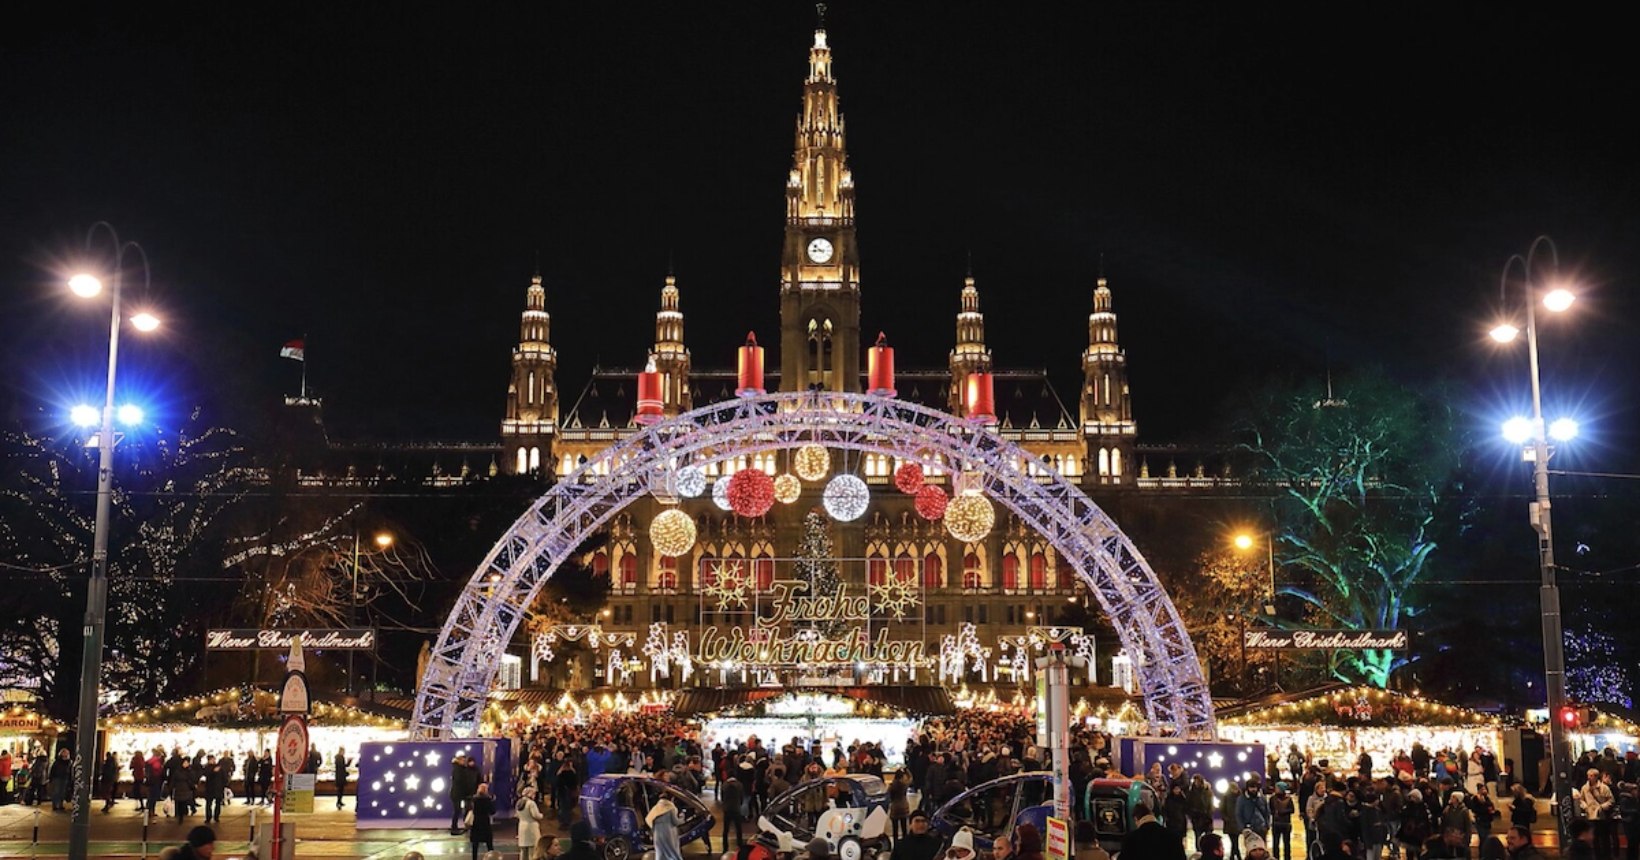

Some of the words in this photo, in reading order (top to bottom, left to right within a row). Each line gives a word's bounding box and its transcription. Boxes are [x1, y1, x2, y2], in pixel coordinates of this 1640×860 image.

[758, 580, 869, 627] Frohe
[208, 631, 255, 648] Wiener
[257, 630, 374, 648] Chriskindlmarkt
[701, 626, 925, 664] Weihnachten
[1245, 631, 1290, 648] Wiener
[1293, 631, 1406, 648] Christkindlmarkt
